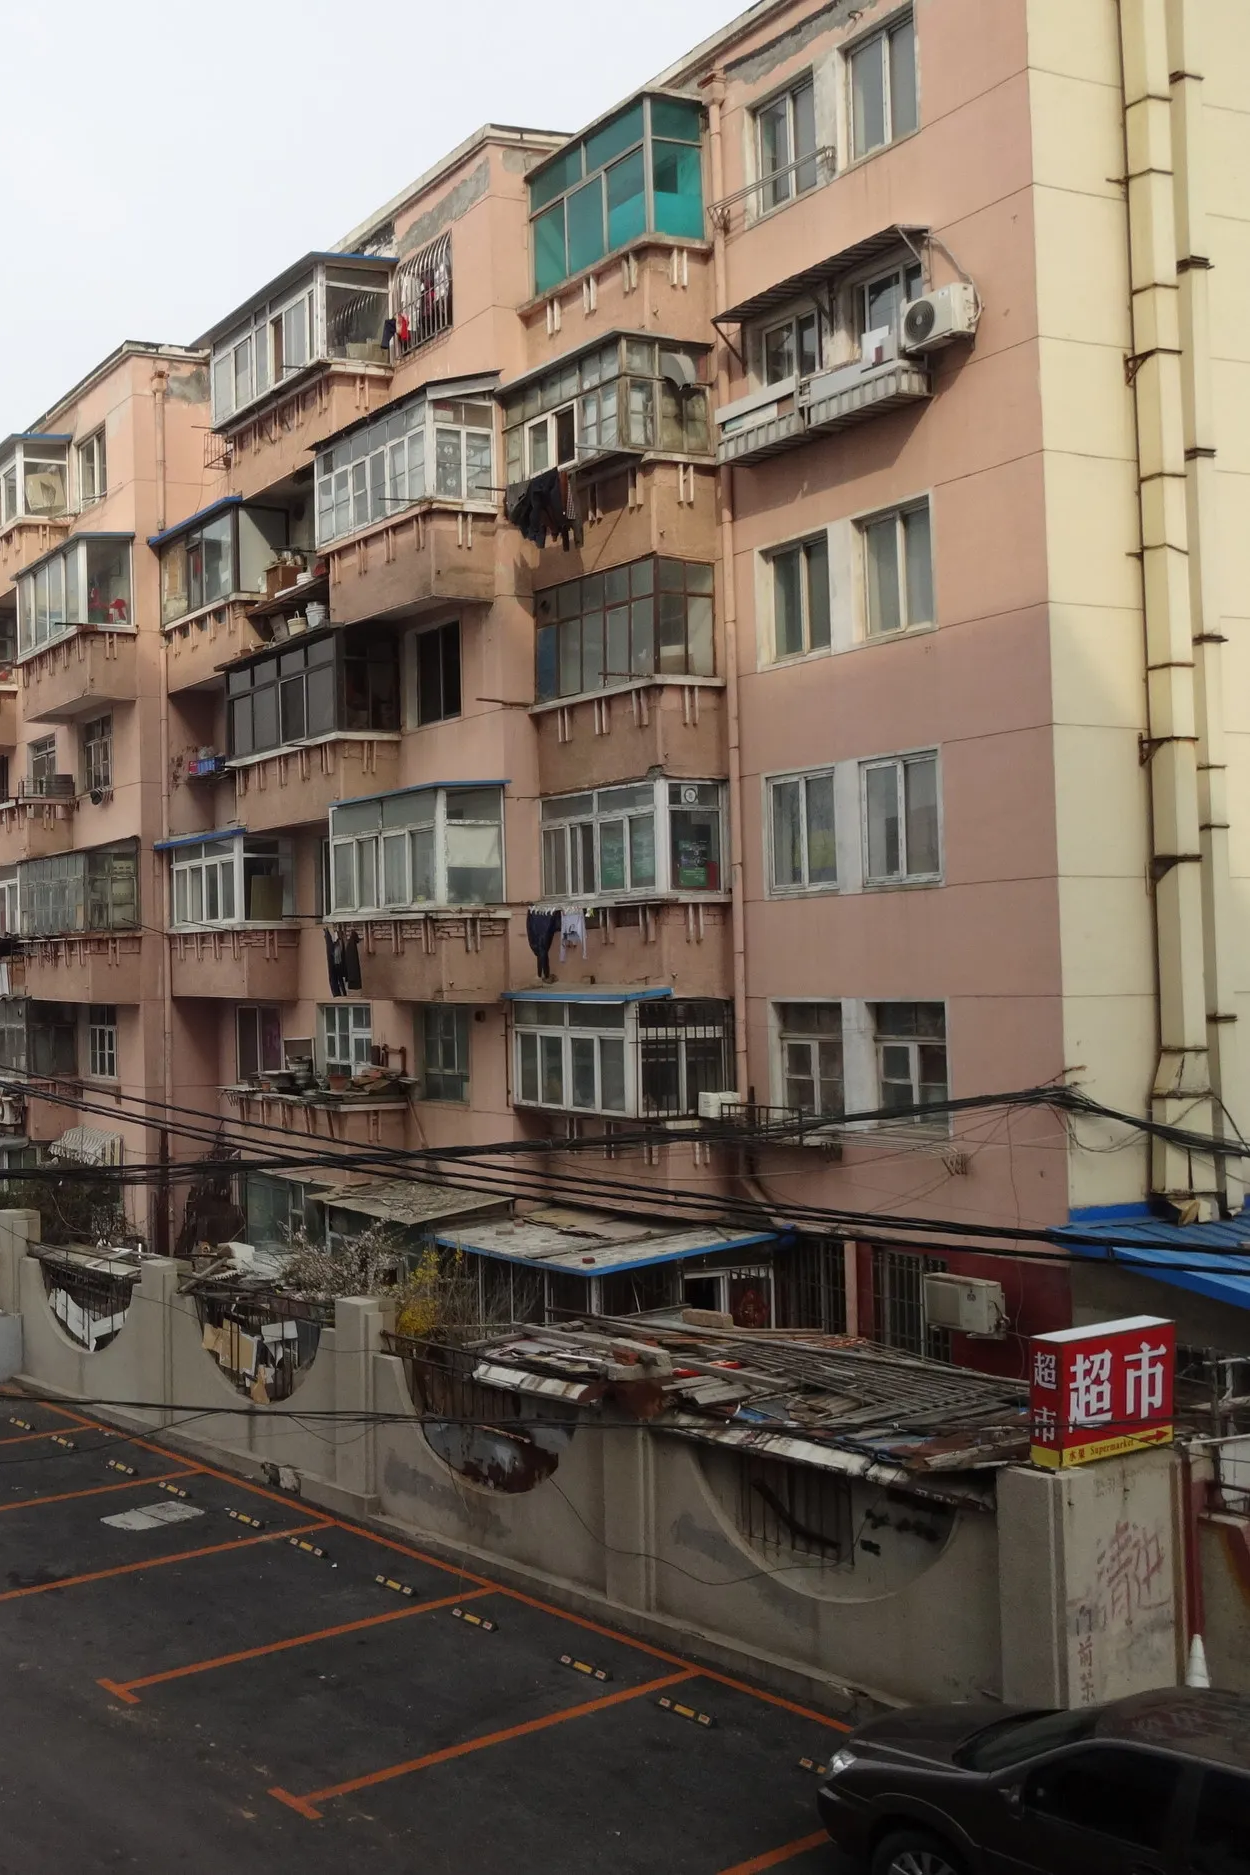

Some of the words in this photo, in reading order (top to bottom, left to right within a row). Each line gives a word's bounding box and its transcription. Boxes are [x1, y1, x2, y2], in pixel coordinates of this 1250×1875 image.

[1033, 1351, 1057, 1443] 超市
[1068, 1341, 1167, 1434] 超市
[1090, 1437, 1135, 1456] Supermarket
